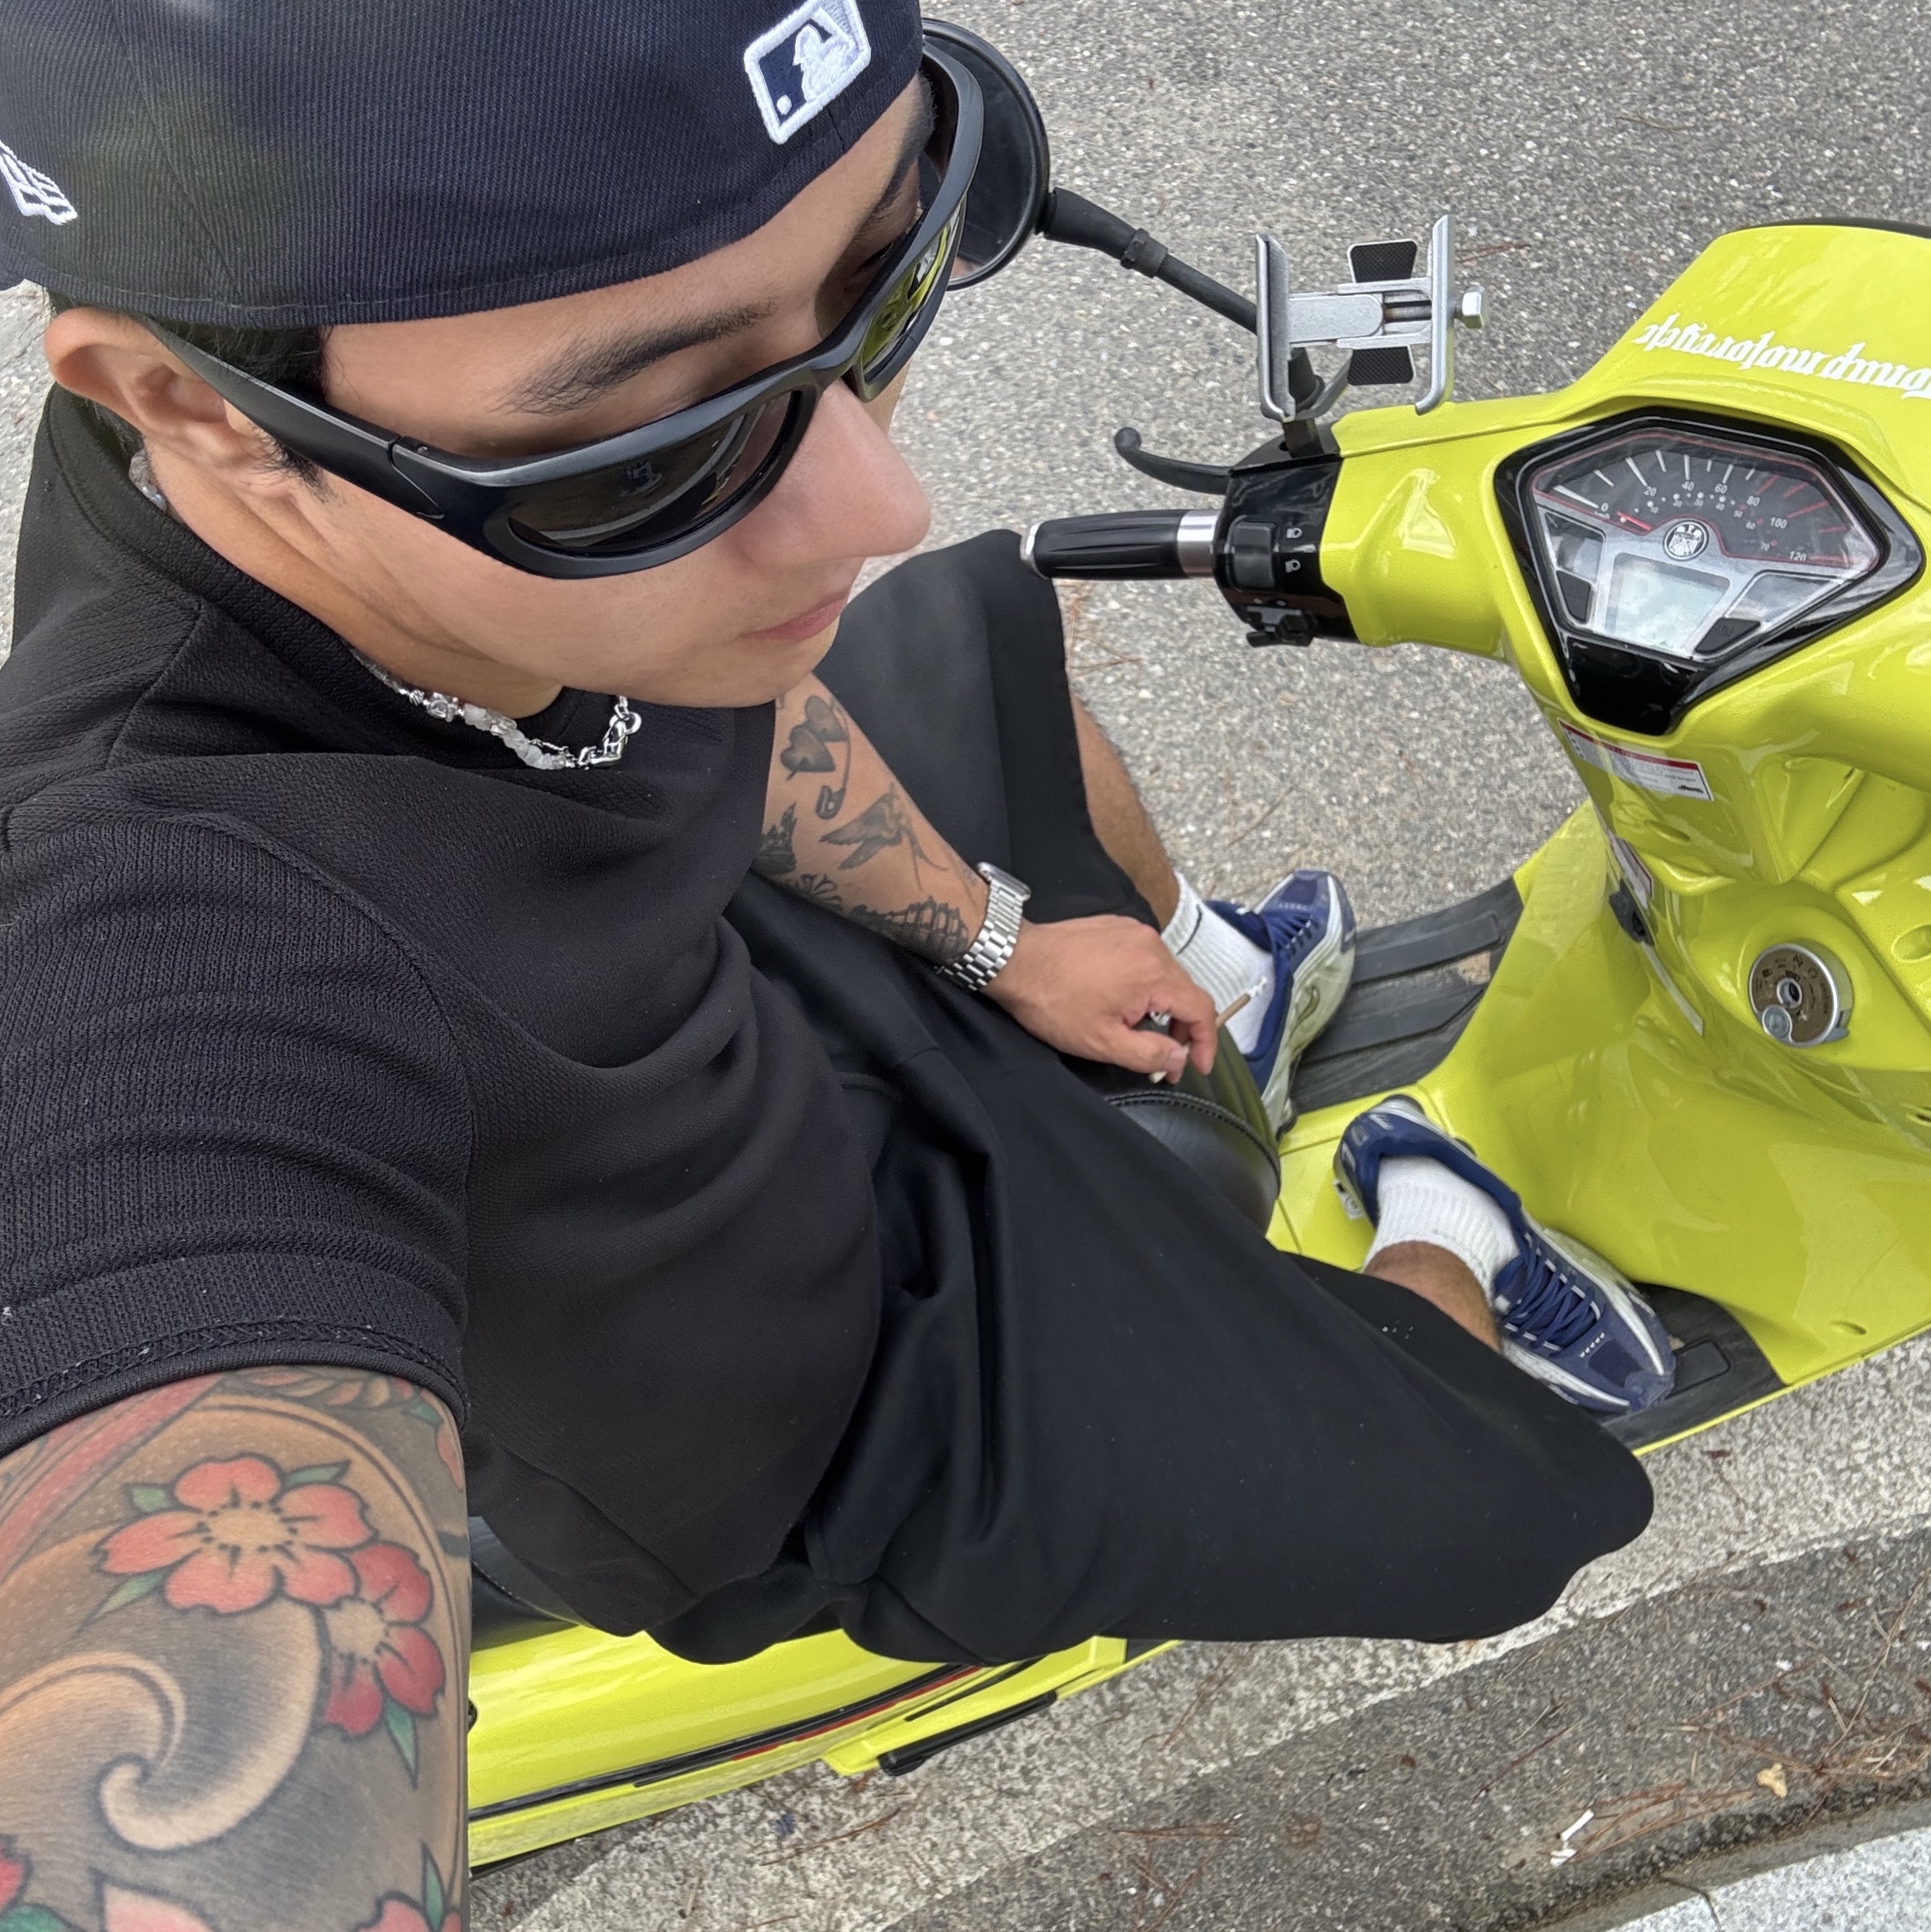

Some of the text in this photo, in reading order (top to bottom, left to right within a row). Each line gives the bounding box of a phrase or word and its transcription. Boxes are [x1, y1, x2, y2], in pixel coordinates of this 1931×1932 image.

[1644, 486, 1657, 496] 20
[1682, 481, 1695, 491] 40
[1715, 483, 1728, 494] 60
[1747, 495, 1760, 506] 80
[1601, 502, 1609, 512] 0
[1770, 516, 1788, 529] 100
[1790, 550, 1807, 562] 120
